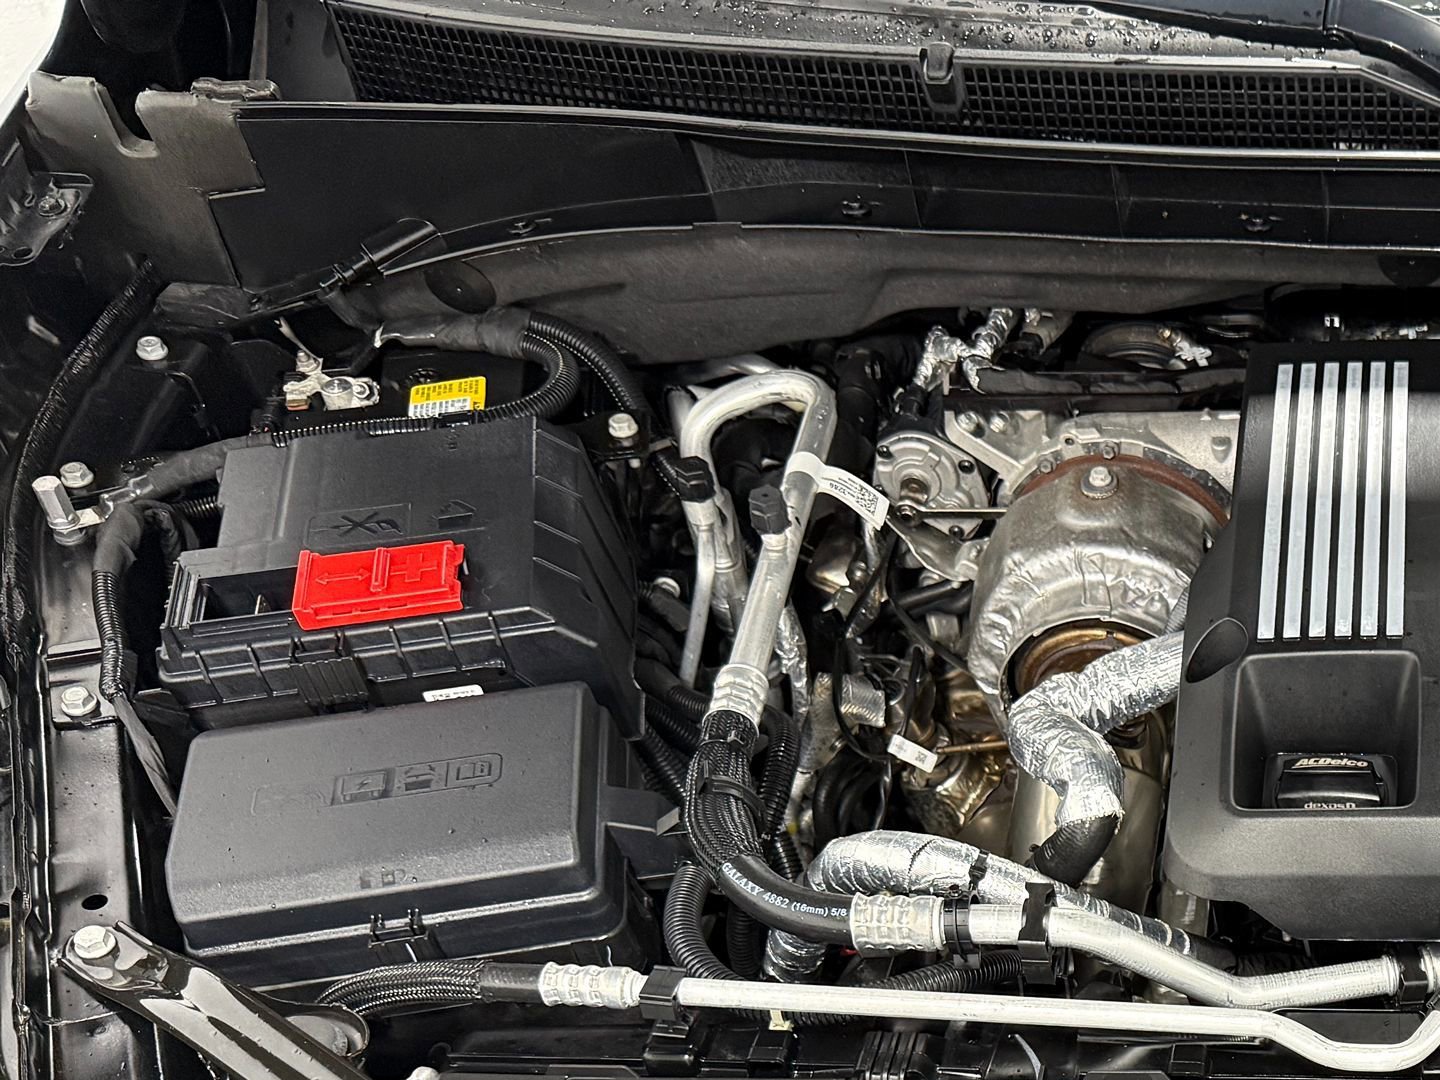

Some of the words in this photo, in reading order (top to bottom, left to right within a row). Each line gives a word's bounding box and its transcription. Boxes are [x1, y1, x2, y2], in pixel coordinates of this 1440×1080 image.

[1295, 758, 1369, 768] ACDelco
[722, 862, 764, 896] GALAXY
[762, 892, 790, 908] 4882
